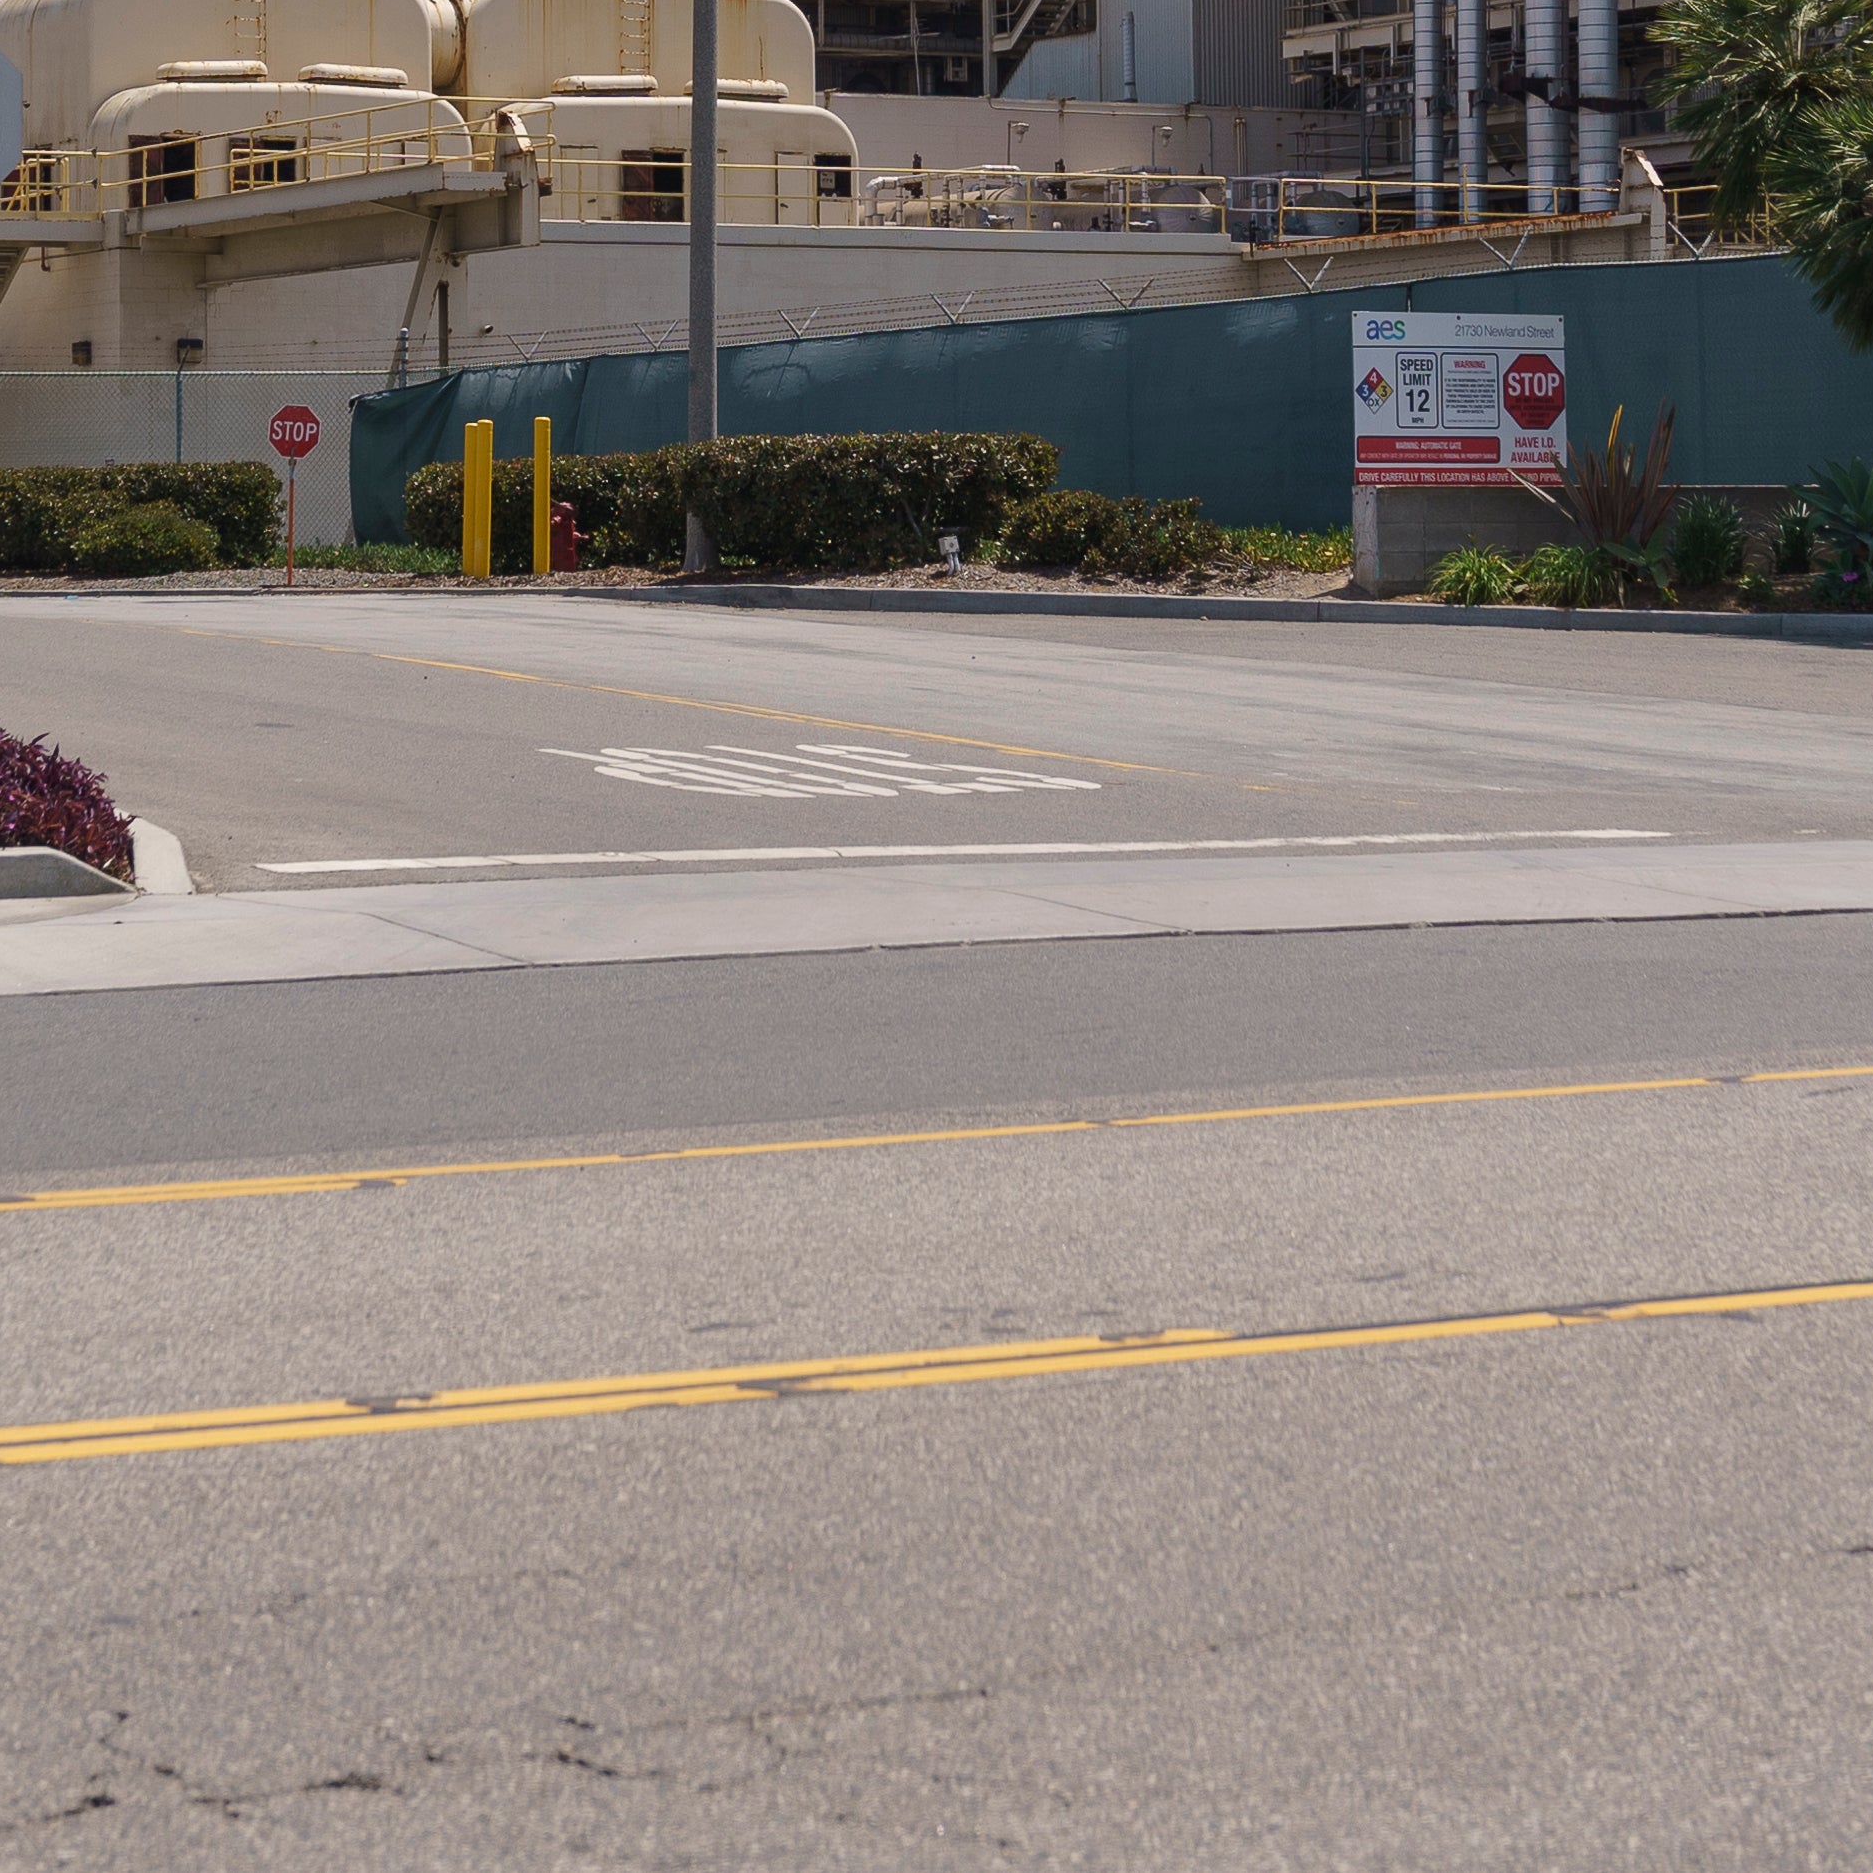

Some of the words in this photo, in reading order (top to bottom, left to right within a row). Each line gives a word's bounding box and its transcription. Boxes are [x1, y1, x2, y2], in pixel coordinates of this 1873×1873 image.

[1366, 319, 1406, 340] aes
[1454, 325, 1482, 337] 21730
[1484, 325, 1525, 338] Newland
[1526, 326, 1555, 338] Street
[1400, 359, 1433, 372] SPEED
[1369, 373, 1378, 384] 4
[1402, 373, 1431, 386] LIMIT
[1508, 372, 1560, 397] STOP
[1361, 385, 1370, 397] 3
[1380, 385, 1388, 396] 3
[1405, 389, 1430, 413] 12
[272, 420, 318, 442] STOP
[1514, 436, 1539, 448] HAVE
[1541, 436, 1557, 448] I.D.
[1510, 452, 1561, 463] AVAILABE
[1359, 472, 1380, 482] DRIVE
[1380, 472, 1419, 482] CAREFULLY
[1420, 472, 1436, 482] THIS
[1437, 472, 1470, 482] LOCATION
[1471, 472, 1486, 482] HAS
[1487, 472, 1509, 482] ABOVE
